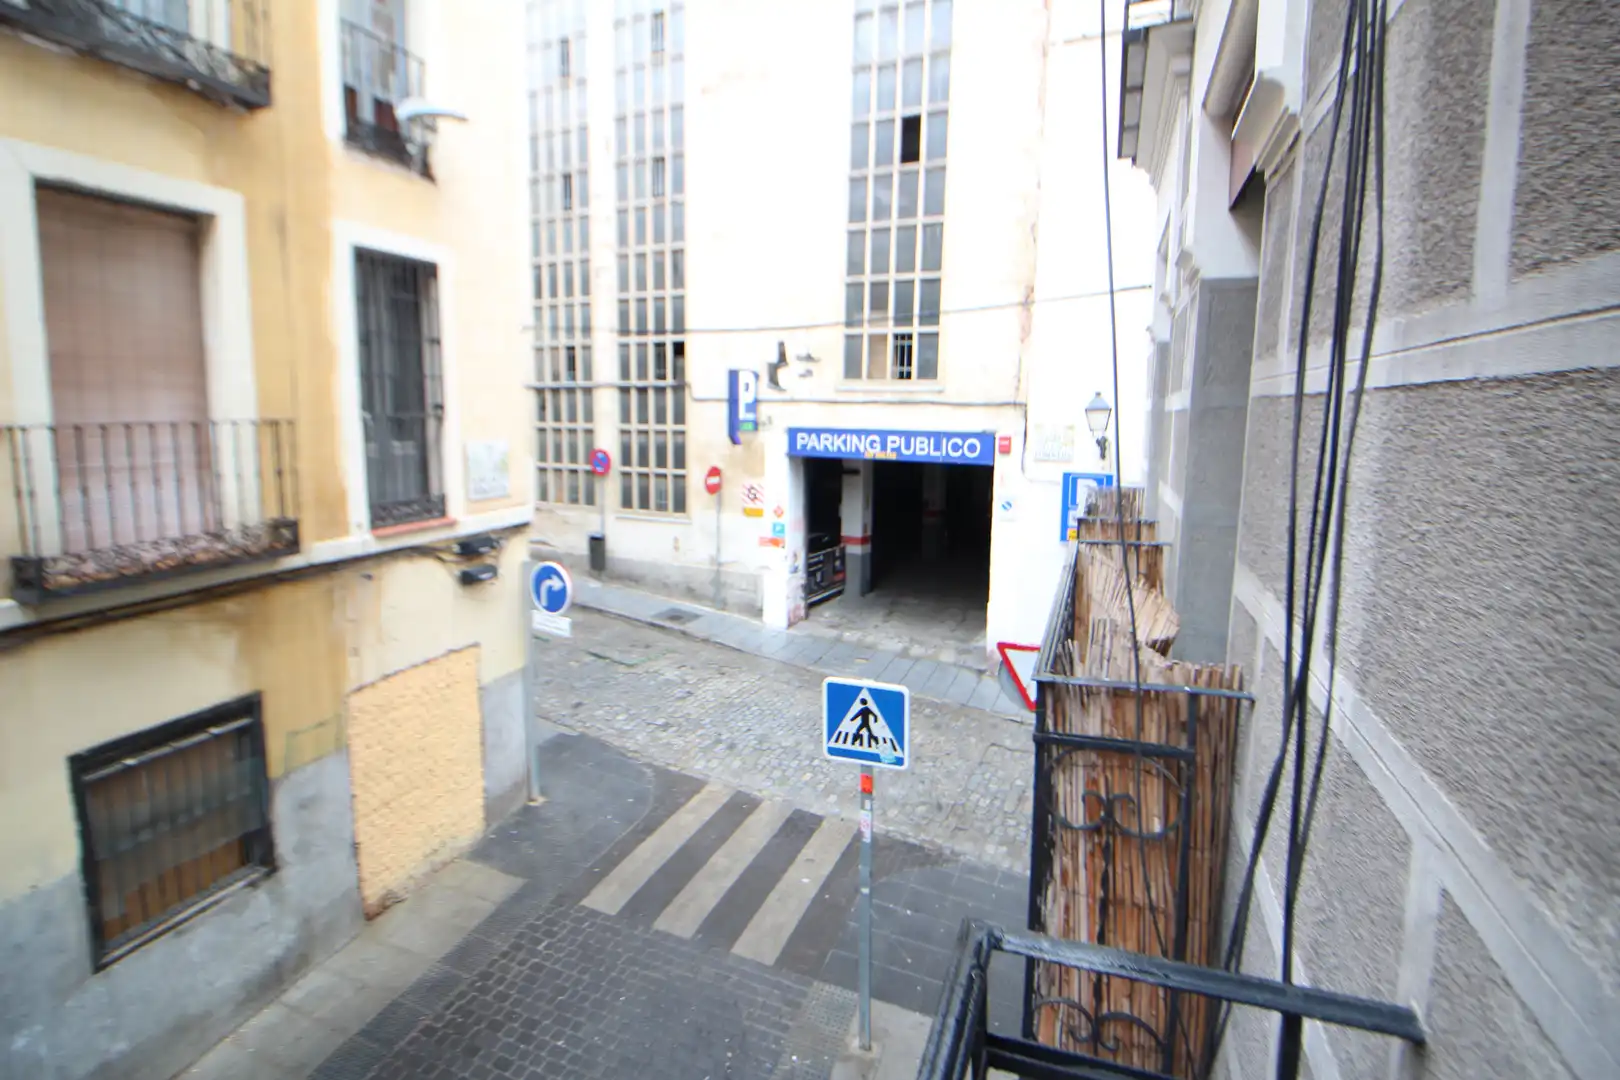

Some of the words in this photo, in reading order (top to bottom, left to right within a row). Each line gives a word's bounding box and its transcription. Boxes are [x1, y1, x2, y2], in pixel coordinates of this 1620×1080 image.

[739, 370, 756, 419] P
[797, 432, 881, 454] PARKING
[886, 435, 981, 458] PUBLICO
